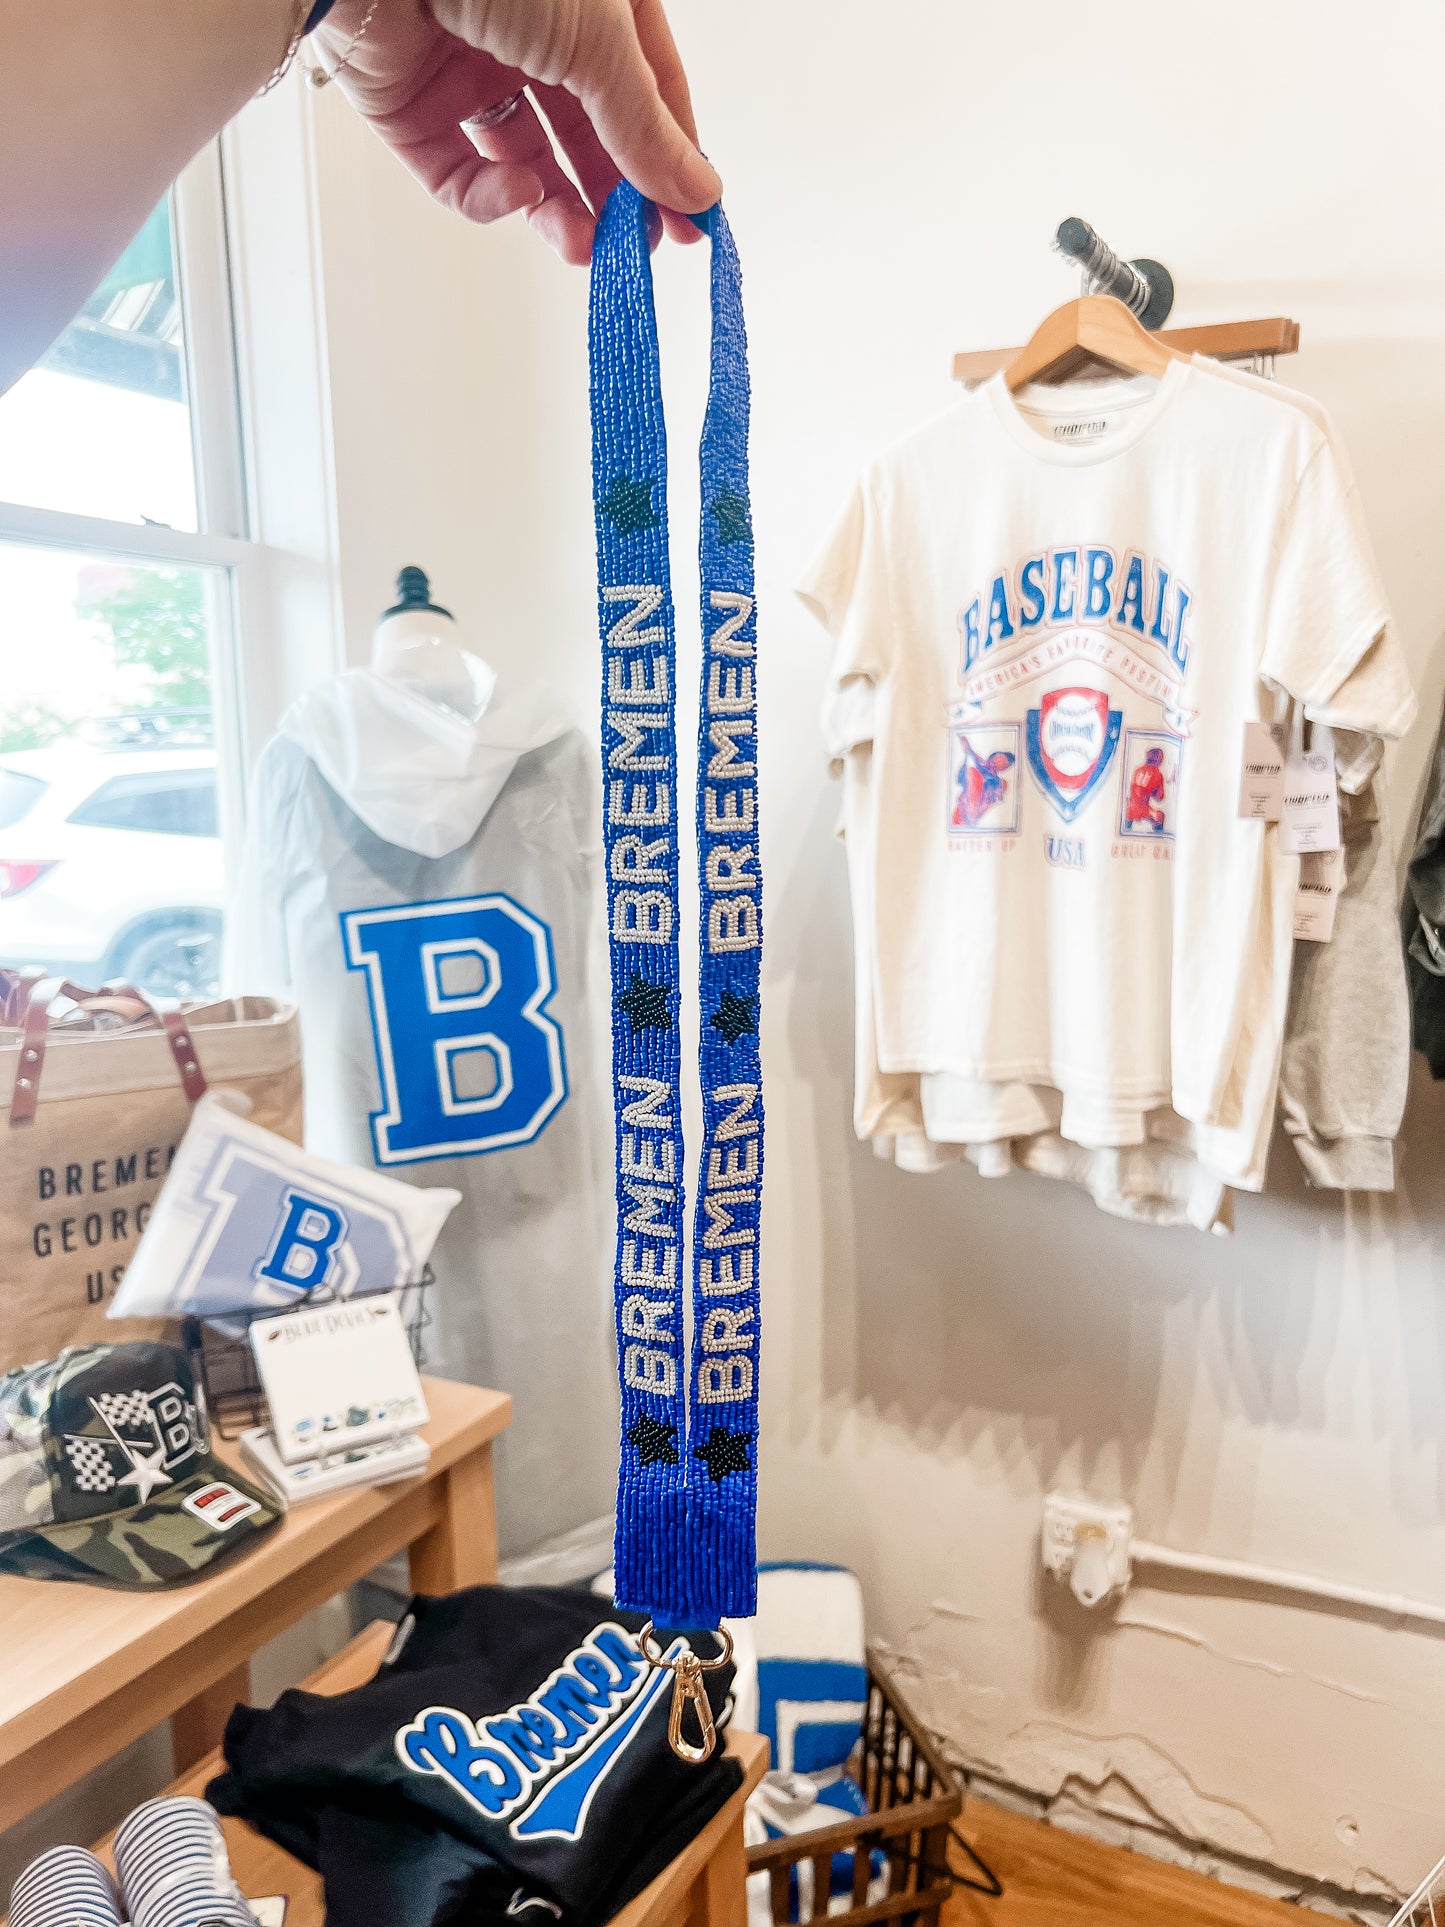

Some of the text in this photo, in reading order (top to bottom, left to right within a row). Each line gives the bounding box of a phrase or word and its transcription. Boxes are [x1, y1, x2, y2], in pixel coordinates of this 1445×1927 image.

[602, 584, 673, 945] BREMEN
[704, 590, 760, 954] BREMEN
[1045, 836, 1086, 869] USA
[339, 891, 570, 1168] B
[33, 1202, 151, 1257] GEORG
[257, 1188, 347, 1293] B
[618, 1075, 677, 1397] BREMEN
[698, 1083, 760, 1404] BREMEN
[394, 1621, 661, 1819] Bremen
